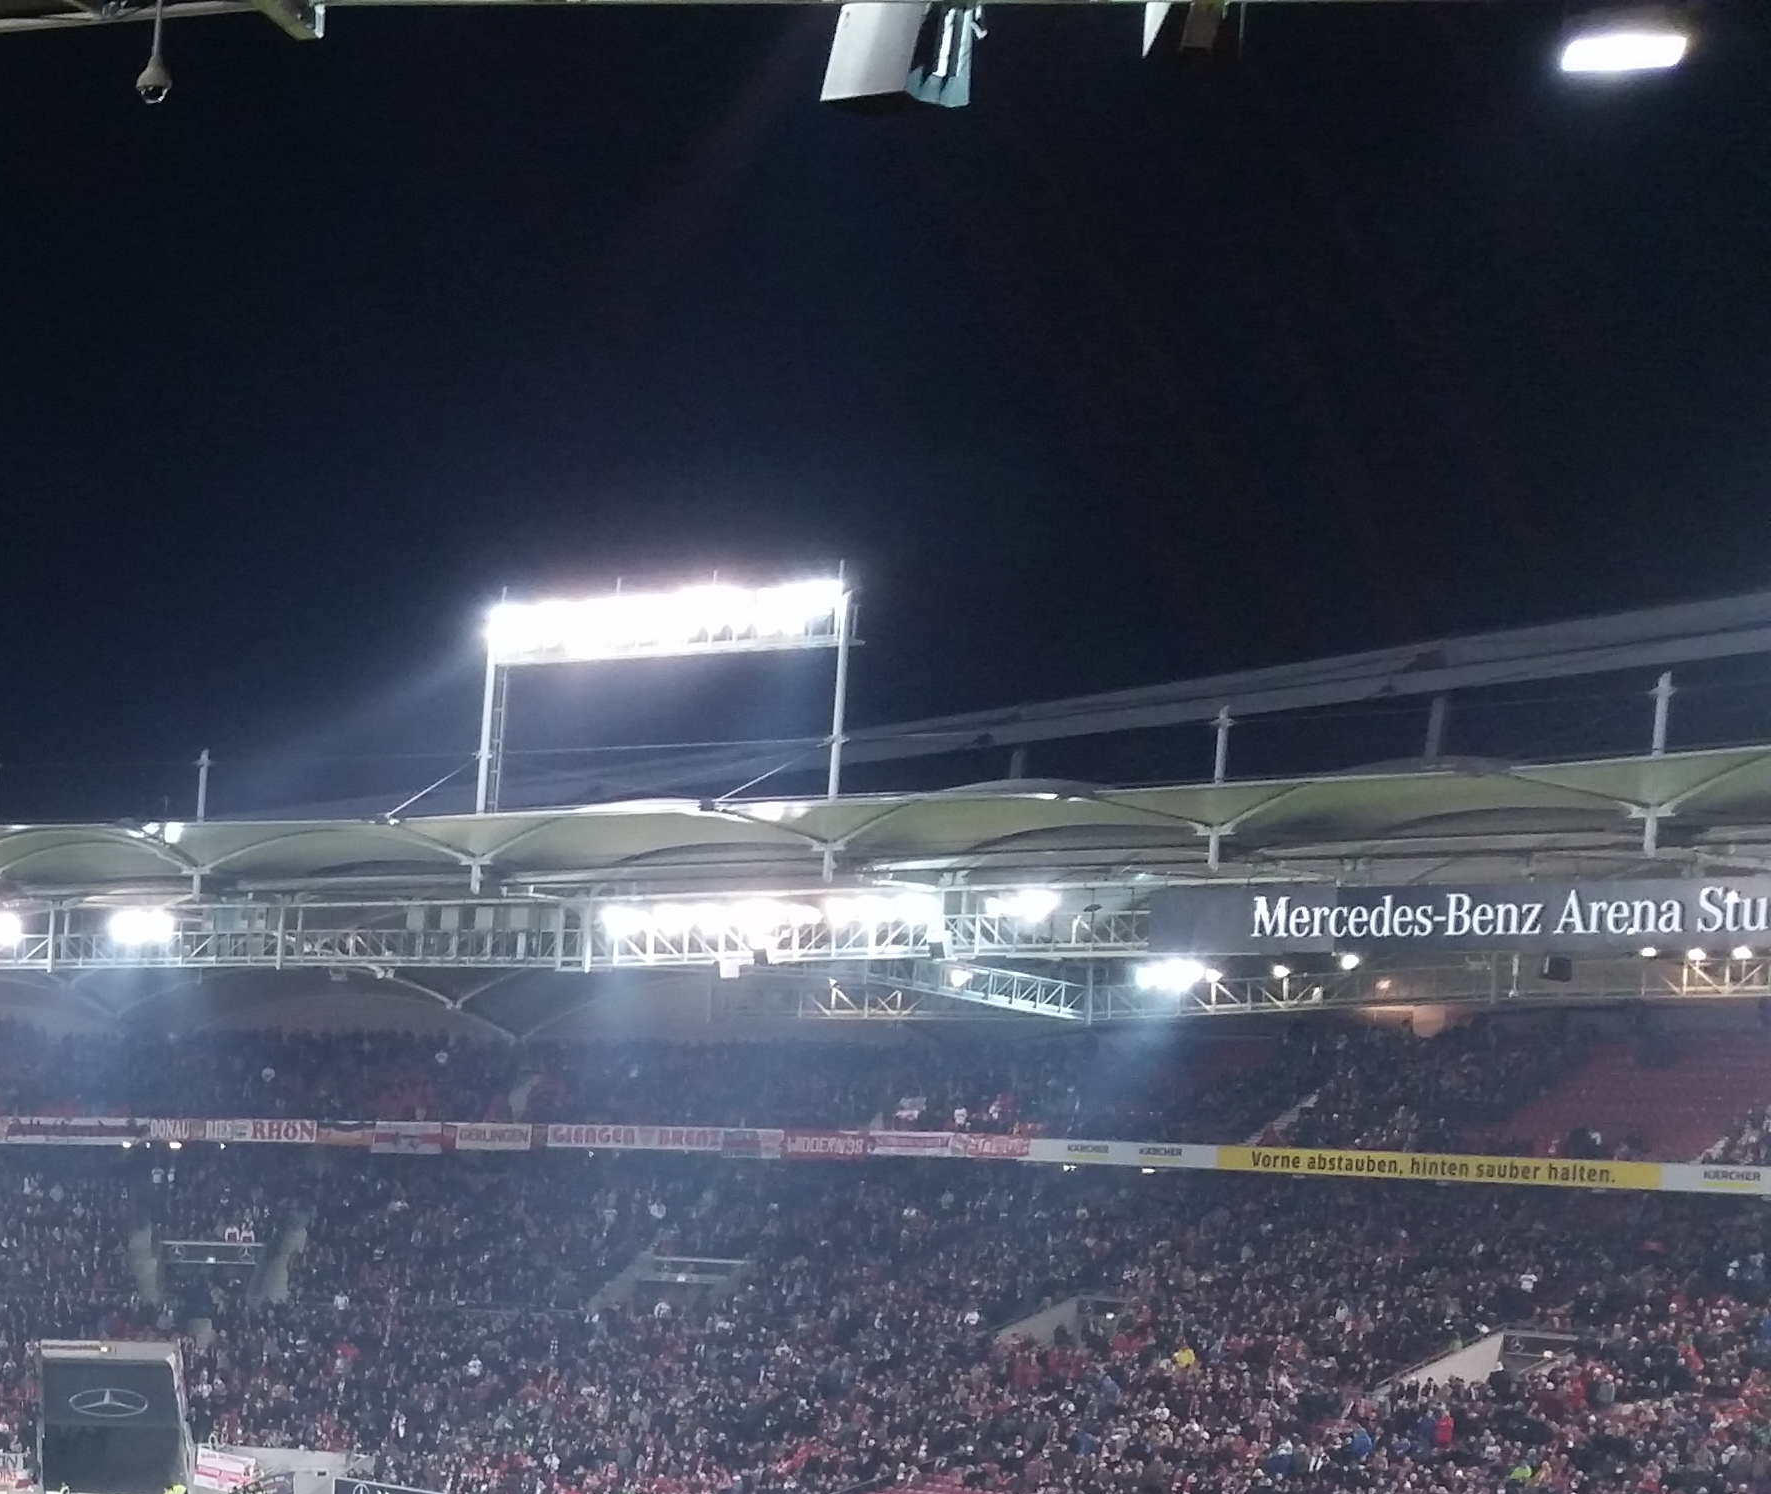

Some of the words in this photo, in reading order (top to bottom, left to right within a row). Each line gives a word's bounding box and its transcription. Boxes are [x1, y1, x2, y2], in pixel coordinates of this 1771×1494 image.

[1251, 893, 1542, 938] Mercedes-Benz
[1553, 889, 1682, 935] Arena
[150, 1119, 190, 1139] DONAU
[1251, 1150, 1301, 1170] Vorne
[1307, 1153, 1404, 1177] abstauben,
[1410, 1156, 1470, 1177] hinten
[1475, 1161, 1541, 1181] sauber
[1547, 1164, 1616, 1184] halten.
